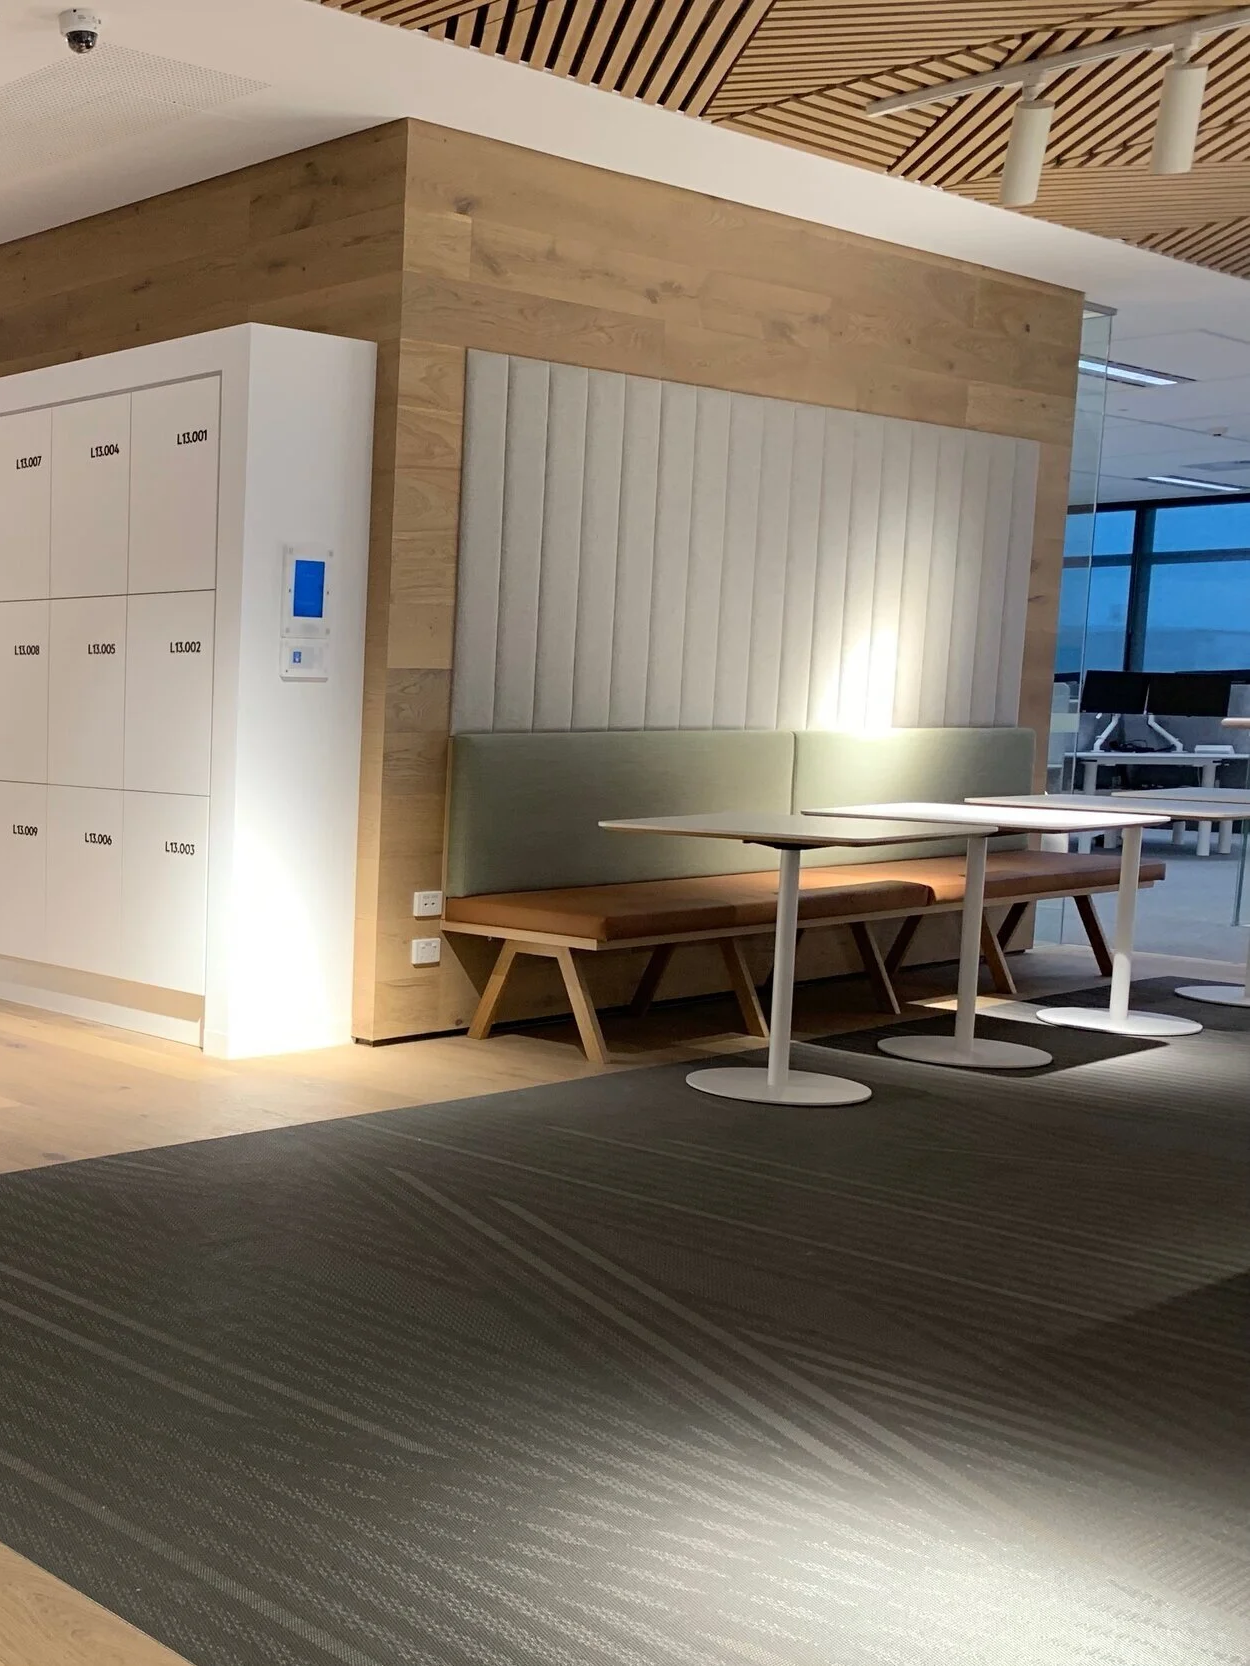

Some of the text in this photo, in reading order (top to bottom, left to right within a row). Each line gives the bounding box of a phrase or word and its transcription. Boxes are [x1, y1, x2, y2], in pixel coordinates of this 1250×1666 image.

[177, 429, 207, 445] L13.001
[91, 444, 119, 458] L13.004
[16, 456, 42, 470] L13.007
[15, 645, 39, 655] L13.008
[88, 644, 115, 654] L13.005
[170, 641, 201, 653] L13.002
[13, 825, 38, 836] L13.009
[85, 833, 112, 845] L13.006
[165, 841, 194, 855] L13.003
